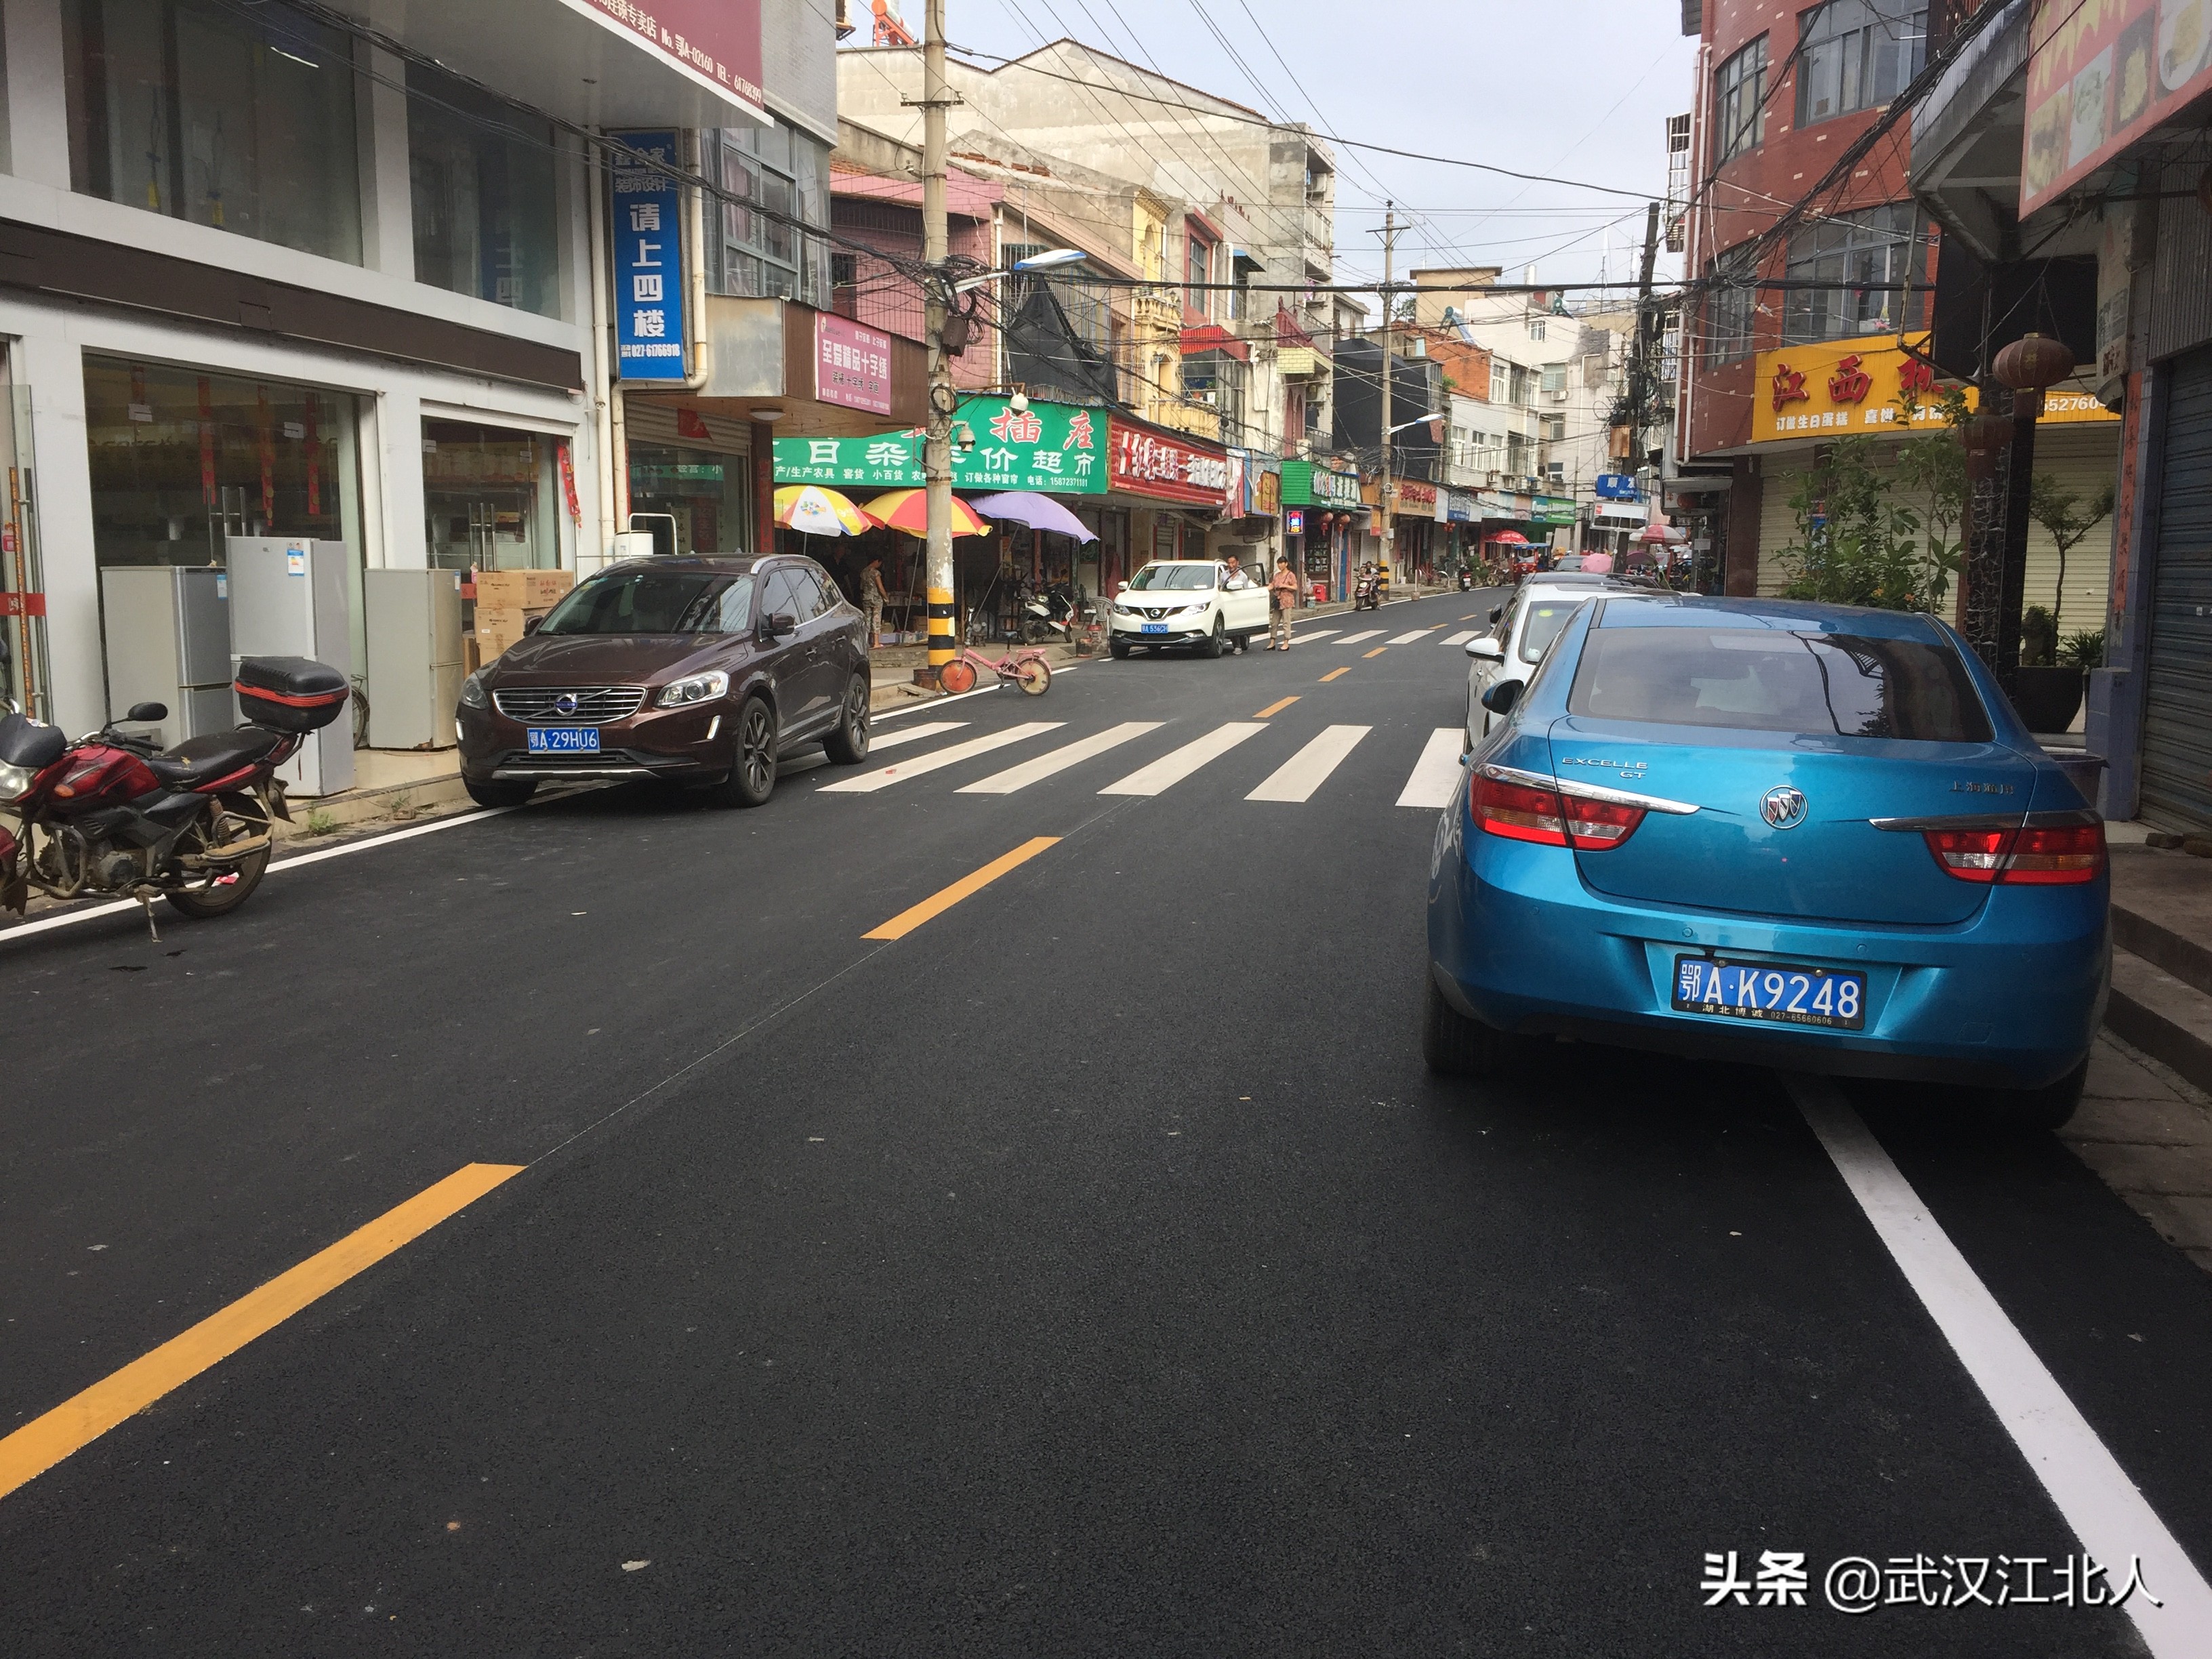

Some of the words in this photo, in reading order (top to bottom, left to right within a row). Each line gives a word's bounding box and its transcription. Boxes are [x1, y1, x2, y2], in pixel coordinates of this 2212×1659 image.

[594, 0, 656, 39] 连锁专卖店
[630, 203, 665, 337] 请上四楼
[822, 339, 888, 380] 至爱精品十字绣
[2044, 396, 2106, 411] 52760
[989, 406, 1094, 451] 插座
[1776, 411, 1849, 431] 订做生日蛋糕
[872, 469, 904, 481] 小百货
[964, 472, 1019, 485] 订做各种窗帘
[1561, 757, 1647, 769] EXCELLE
[1620, 771, 1646, 779] GT
[1770, 1011, 1832, 1025] 027-65660606
